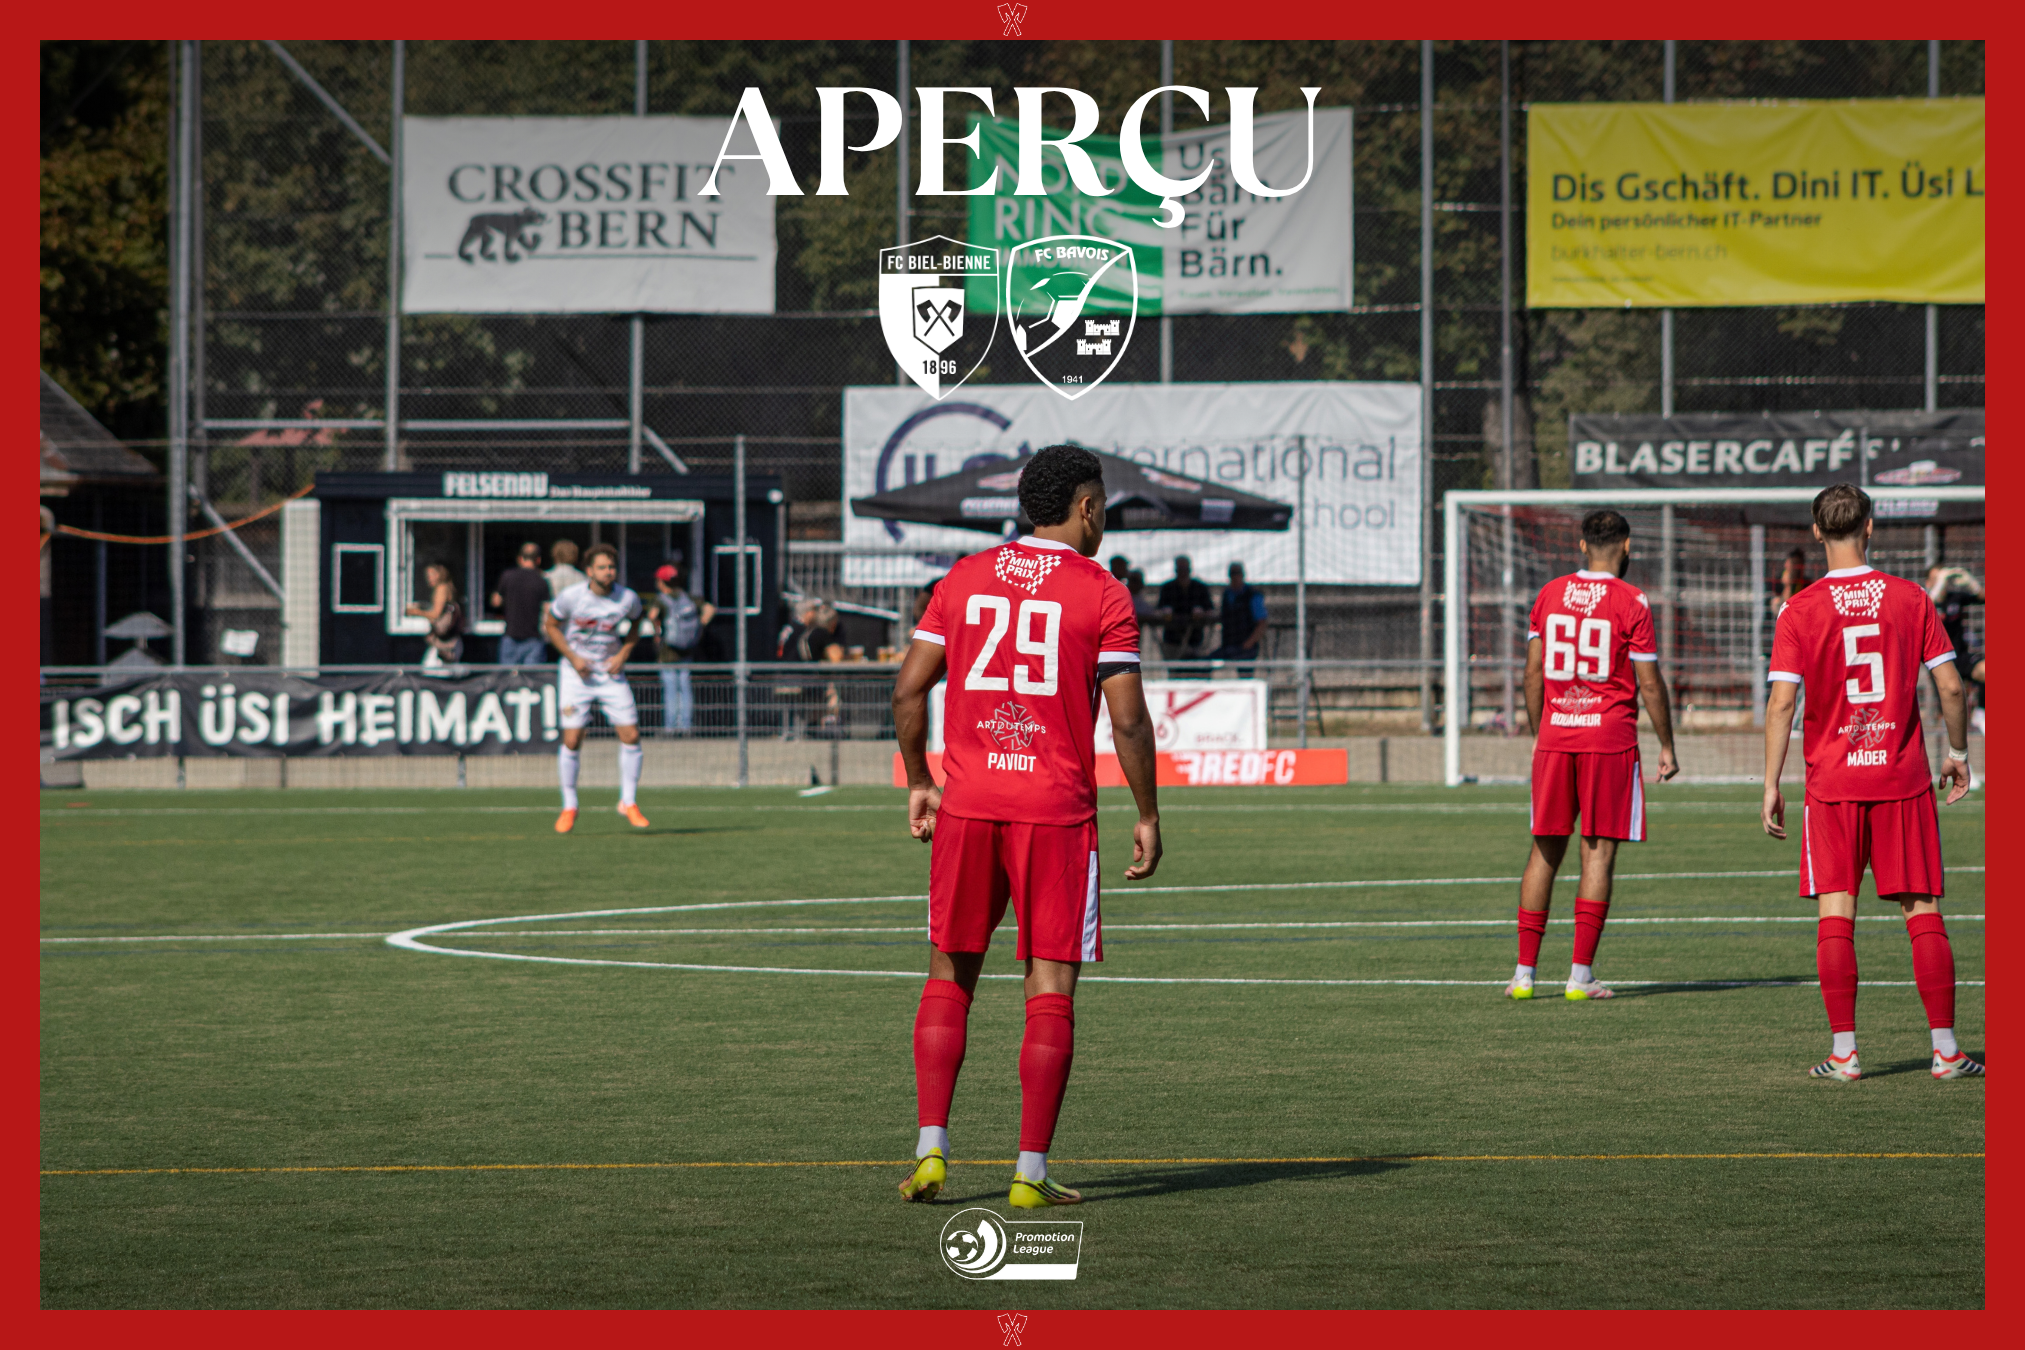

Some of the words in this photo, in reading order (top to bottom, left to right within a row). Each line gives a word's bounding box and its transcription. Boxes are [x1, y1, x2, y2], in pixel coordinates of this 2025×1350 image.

[449, 163, 734, 203] CROSSFIT
[995, 155, 1128, 196] NOD
[1552, 172, 1606, 201] Dis
[1616, 171, 1760, 201] Gschäft.
[1773, 171, 1840, 199] Dini
[1852, 170, 1890, 199] IT.
[1902, 161, 1954, 198] Üsi
[557, 210, 719, 249] BERN
[1181, 211, 1245, 240] Für
[1552, 213, 1595, 229] Dein
[1601, 212, 1718, 231] persönlicher
[1724, 212, 1822, 228] IT-Partner
[1180, 247, 1283, 277] Bärn.
[1576, 428, 1855, 475] BLASERCAFÉ
[1292, 500, 1396, 530] chool
[1006, 564, 1037, 579] PRIX
[1009, 556, 1038, 570] MINI
[1843, 588, 1869, 600] MINI
[1845, 599, 1870, 609] PRIX
[965, 594, 1062, 696] 29
[1544, 613, 1611, 682] 69
[1842, 623, 1885, 705] 5
[53, 690, 182, 750] ISCH
[202, 684, 289, 746] ÜSI
[317, 684, 558, 746] HEIMAT!
[1847, 748, 1887, 766] MÄDER
